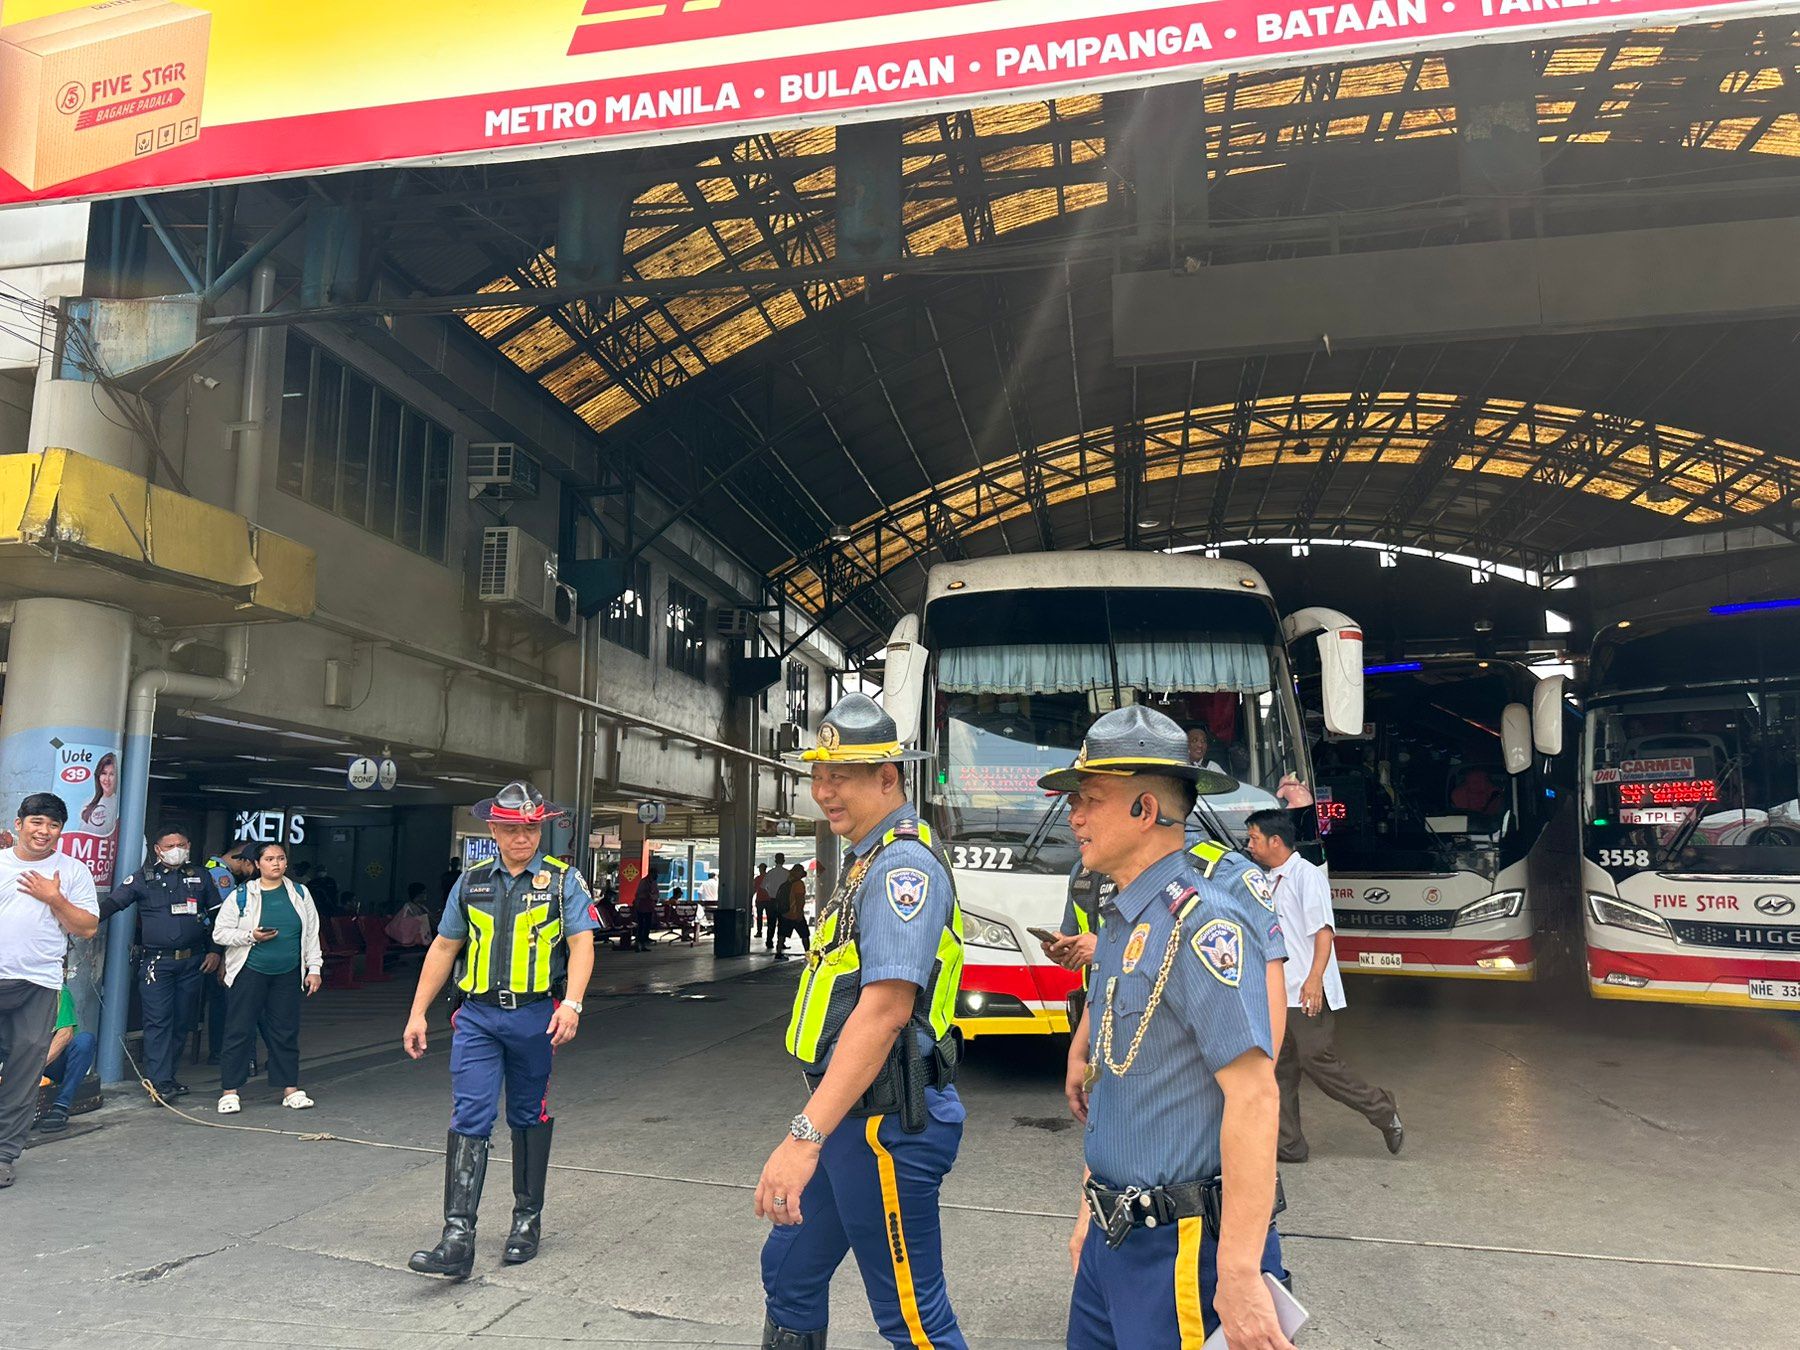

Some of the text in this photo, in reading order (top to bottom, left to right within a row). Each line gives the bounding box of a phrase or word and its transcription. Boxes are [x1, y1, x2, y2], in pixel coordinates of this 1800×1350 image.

[485, 0, 1427, 136] METRO MANILA BULACAN PAMPANGA BATAAN
[92, 62, 186, 102] FIVE STAR
[96, 93, 173, 122] BAGAHE PADALA
[62, 749, 92, 764] Vote
[361, 760, 368, 774] 1
[1622, 759, 1692, 773] CARMEN
[65, 769, 86, 781] 39
[1595, 771, 1616, 781] DAU
[1622, 812, 1641, 823] via
[953, 846, 1013, 869] 3322
[1599, 850, 1650, 867] 3558
[1654, 895, 1739, 911] FIVE STAR
[1351, 914, 1408, 925] HIGER
[1751, 984, 1800, 997] NHE 33
